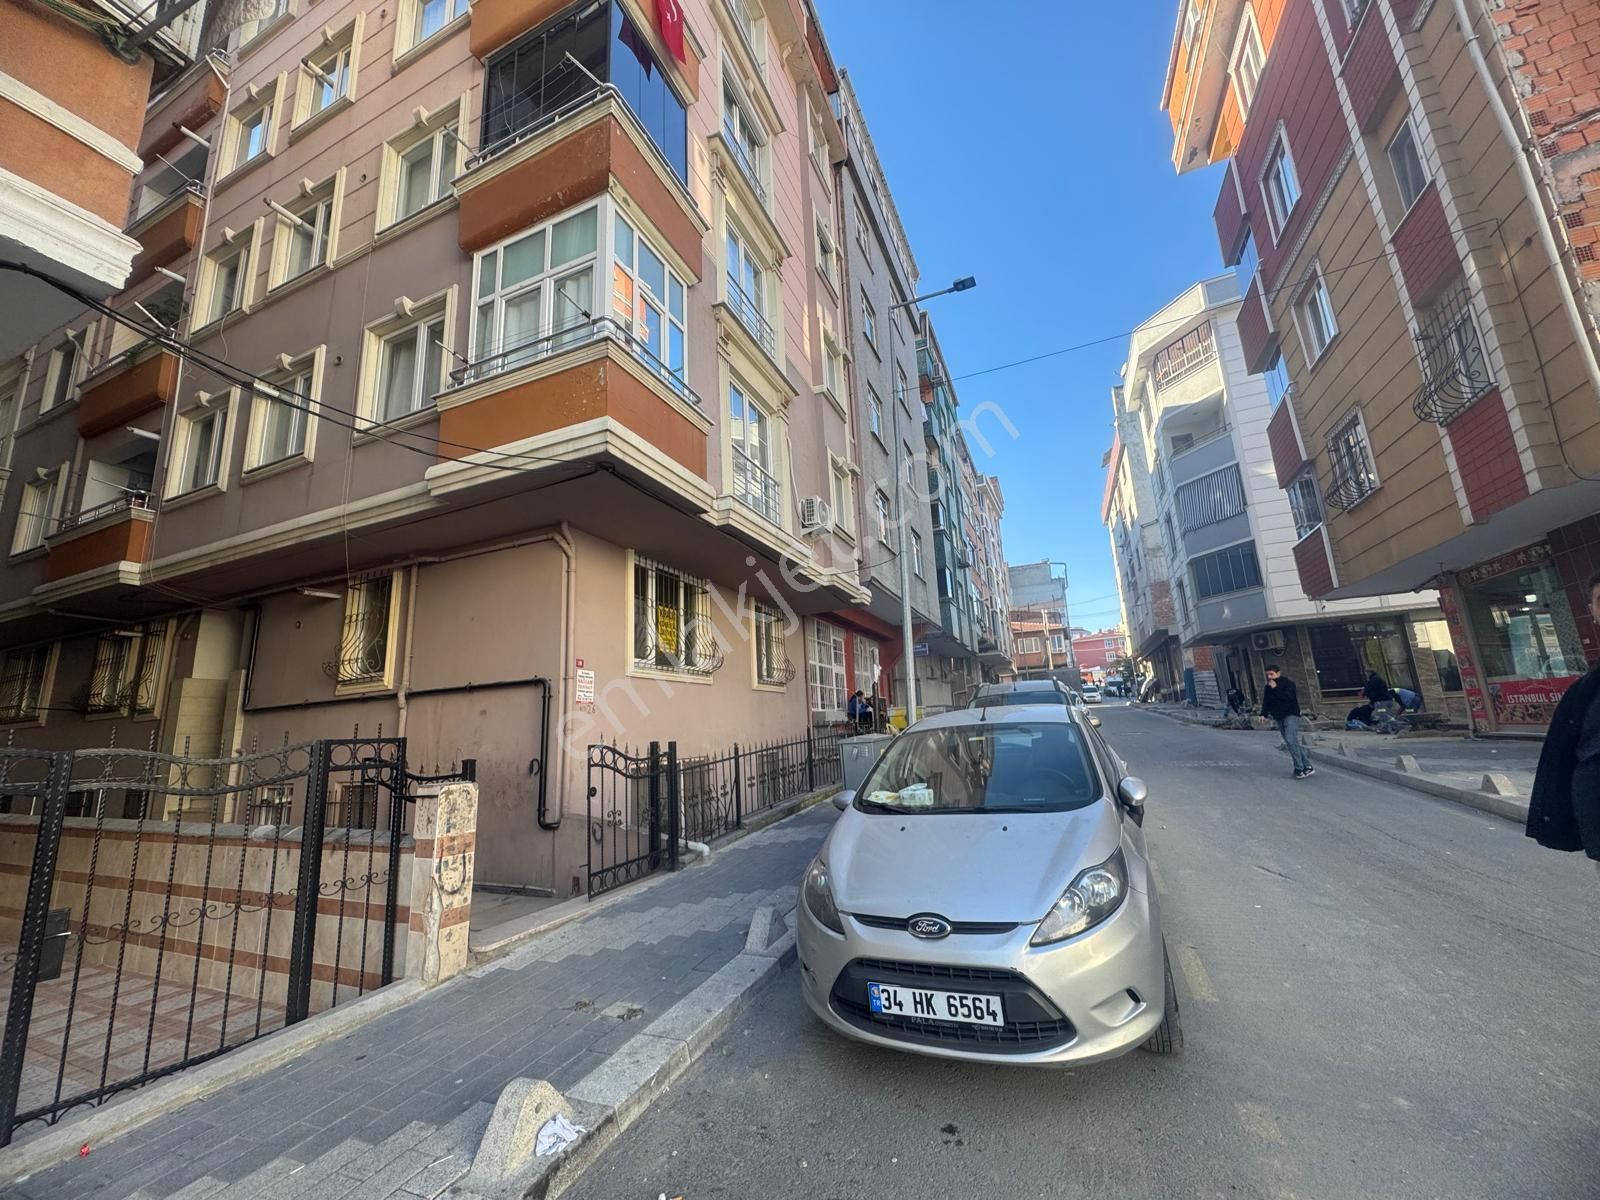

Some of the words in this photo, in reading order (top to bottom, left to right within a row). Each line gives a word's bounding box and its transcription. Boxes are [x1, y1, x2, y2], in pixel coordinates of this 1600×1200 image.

[916, 920, 940, 933] Ford
[881, 988, 904, 1012] 34
[912, 991, 937, 1016] HK
[946, 994, 998, 1023] 6564
